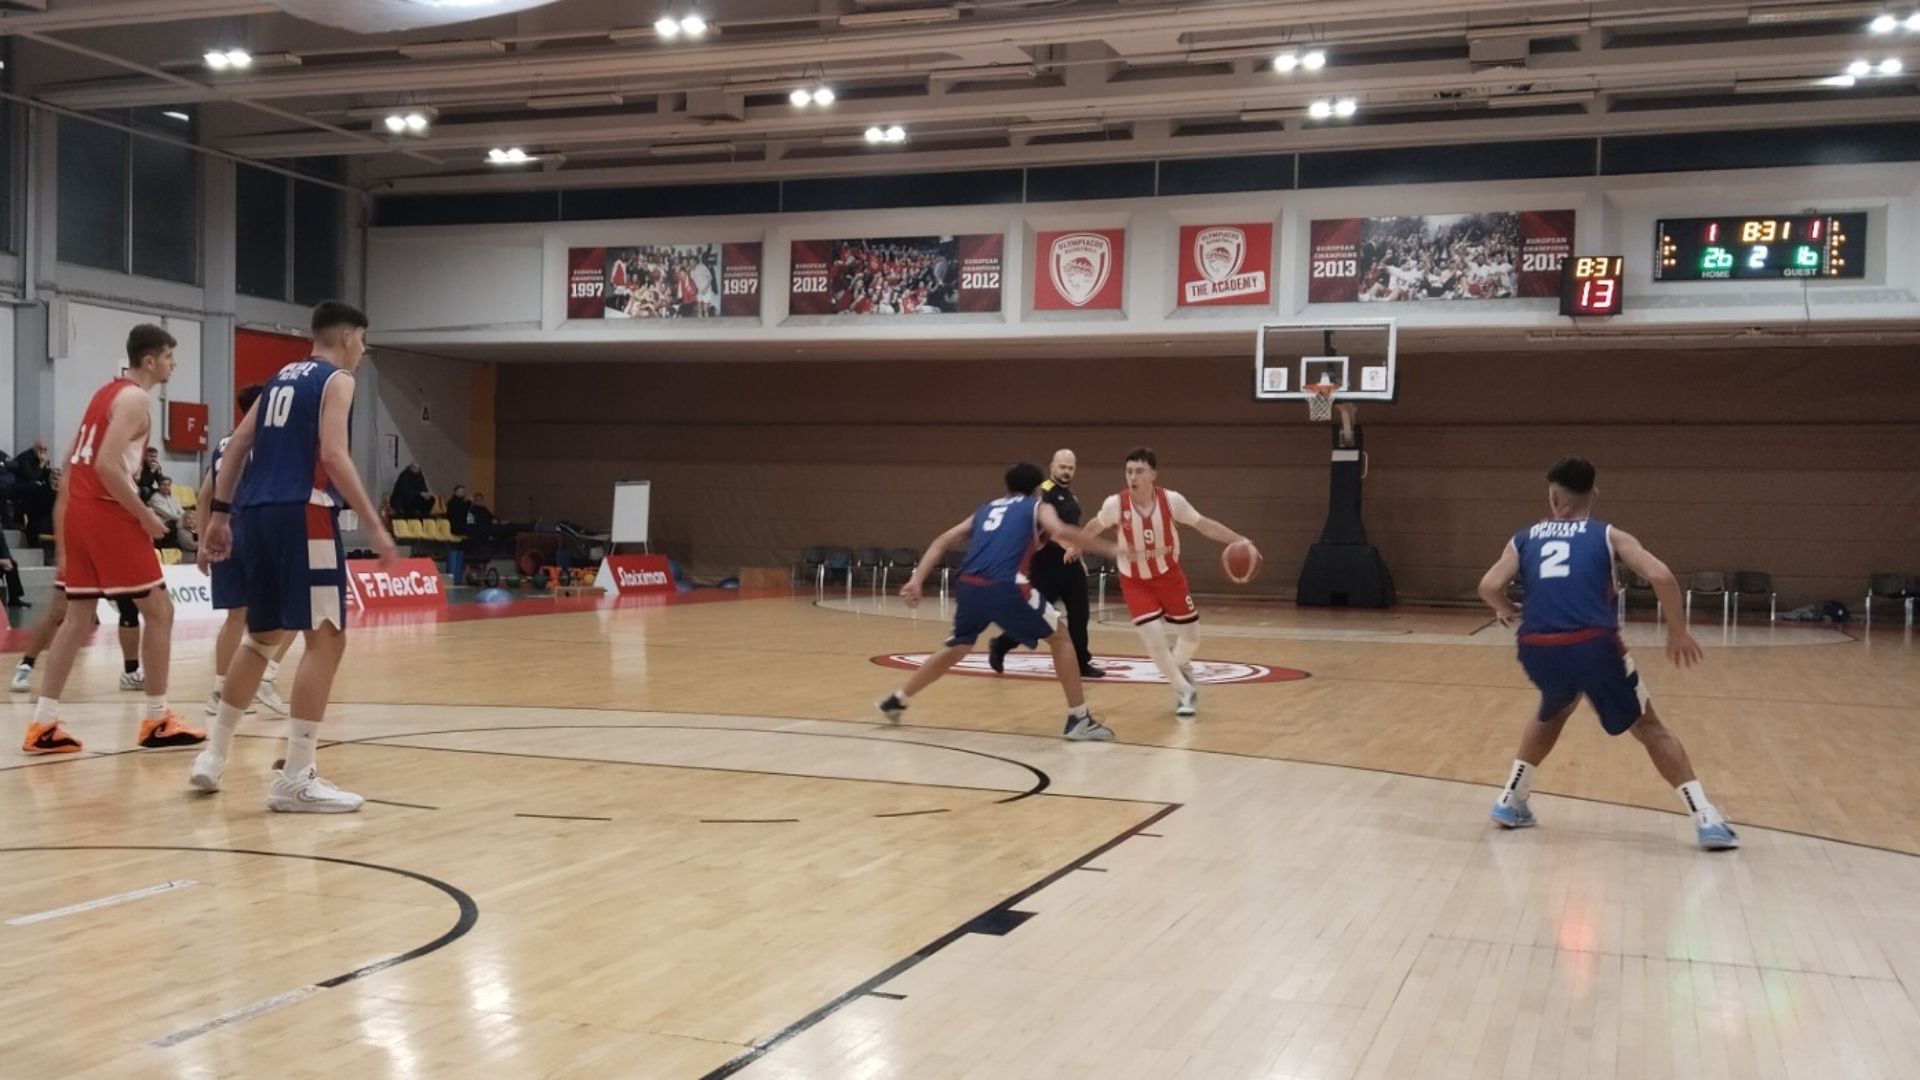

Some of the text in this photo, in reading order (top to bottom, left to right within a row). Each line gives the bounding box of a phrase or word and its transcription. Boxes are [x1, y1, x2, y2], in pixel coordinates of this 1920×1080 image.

[1200, 231, 1240, 241] OLYMPIACOS
[1710, 224, 1718, 242] 1
[1742, 221, 1791, 242] 8:31
[1812, 220, 1820, 238] 1
[1058, 239, 1104, 250] OLYMPIACOS
[1749, 246, 1767, 268] 2
[1313, 261, 1357, 278] 2013
[1576, 258, 1622, 277] 8:31
[1702, 270, 1730, 278] HOME
[1784, 268, 1817, 276] GUEST
[723, 278, 759, 294] 1997
[792, 277, 828, 293] 2012
[962, 273, 1000, 289] 2012
[1191, 276, 1258, 297] THE ACADEMY
[571, 283, 604, 298] 1997
[1581, 280, 1614, 307] 13
[264, 386, 295, 428] 10
[187, 417, 196, 432] F
[71, 423, 97, 465] 14
[982, 507, 1008, 532] 5
[1144, 529, 1154, 544] 9
[1541, 541, 1570, 578] 2
[373, 571, 439, 598] FlexCar
[617, 566, 668, 587] Stoiximan
